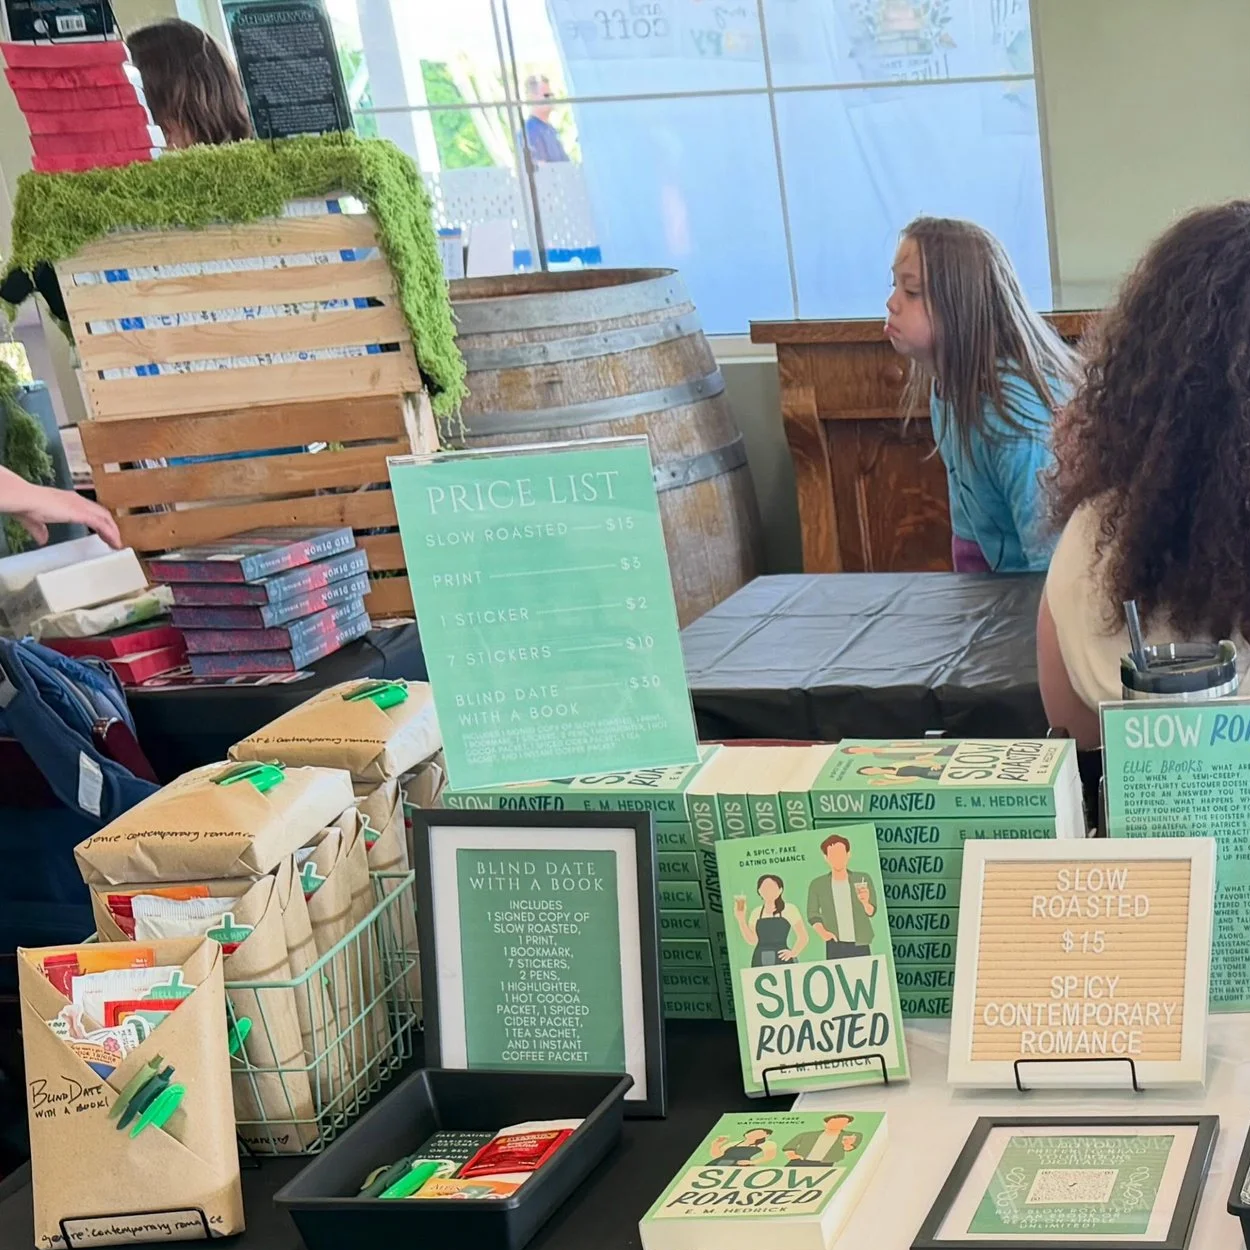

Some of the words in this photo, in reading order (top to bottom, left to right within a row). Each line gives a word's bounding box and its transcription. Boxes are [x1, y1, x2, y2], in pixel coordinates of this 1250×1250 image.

[427, 479, 536, 515] PRICE
[549, 470, 619, 504] LIST
[426, 530, 475, 547] SLOW
[484, 522, 568, 542] ROASTED
[606, 516, 634, 532] $15
[432, 570, 482, 588] PRINT
[455, 608, 529, 626] STICKER
[626, 596, 648, 611] $2
[466, 646, 552, 666] STICKERS
[626, 636, 654, 650] $10
[456, 690, 505, 707] BLIND
[516, 684, 559, 699] DATE
[458, 710, 500, 726] WITH
[530, 702, 580, 718] BOOK
[1124, 714, 1202, 749] SLOW
[1123, 760, 1152, 774] ELLIE
[1161, 759, 1203, 773] BROOKS
[820, 794, 864, 813] SLOW
[869, 792, 935, 812] ROASTED
[955, 797, 967, 808] E.
[971, 797, 986, 808] M.
[989, 795, 1047, 807] HEDRICK
[477, 862, 536, 875] BLIND
[546, 862, 596, 875] DATE
[739, 858, 767, 867] DATING
[769, 855, 806, 865] ROMANCE
[470, 878, 520, 890] WITH
[530, 879, 541, 890] A
[552, 878, 604, 891] BOOK
[1056, 868, 1128, 892] SLOW
[510, 901, 563, 910] INCLUDES
[1032, 895, 1149, 918] ROASTED
[494, 912, 535, 922] SIGNED
[538, 912, 570, 922] COPY
[574, 913, 590, 922] OF
[494, 924, 524, 934] SLOW
[528, 924, 581, 935] ROASTED,
[526, 936, 557, 946] PRINT,
[511, 947, 574, 958] BOOKMARK,
[508, 960, 513, 968] 7
[517, 959, 570, 970] STICKERS,
[520, 971, 526, 980] 2
[508, 982, 580, 993] HIGHLIGHTER,
[754, 959, 879, 1019] SLOW
[1050, 975, 1120, 999] SPICY
[512, 994, 533, 1003] HOT
[537, 994, 580, 1003] COCOA
[496, 1005, 540, 1016] PACKET,
[550, 1006, 589, 1016] SPICED
[983, 1003, 1176, 1026] CONTEMPORARY
[504, 1017, 536, 1026] CIDER
[540, 1017, 584, 1028] PACKET,
[512, 1028, 531, 1038] TEA
[535, 1028, 580, 1039] SACHET,
[756, 1012, 889, 1060] ROASTED
[507, 1040, 529, 1049] AND
[539, 1040, 581, 1049] INSTANT
[1020, 1030, 1143, 1055] ROMANCE
[502, 1052, 544, 1061] COFFEE
[549, 1052, 589, 1061] PACKET
[691, 1168, 837, 1189] SLOW
[666, 1190, 823, 1208] ROASTED
[175, 1214, 223, 1231] romace
